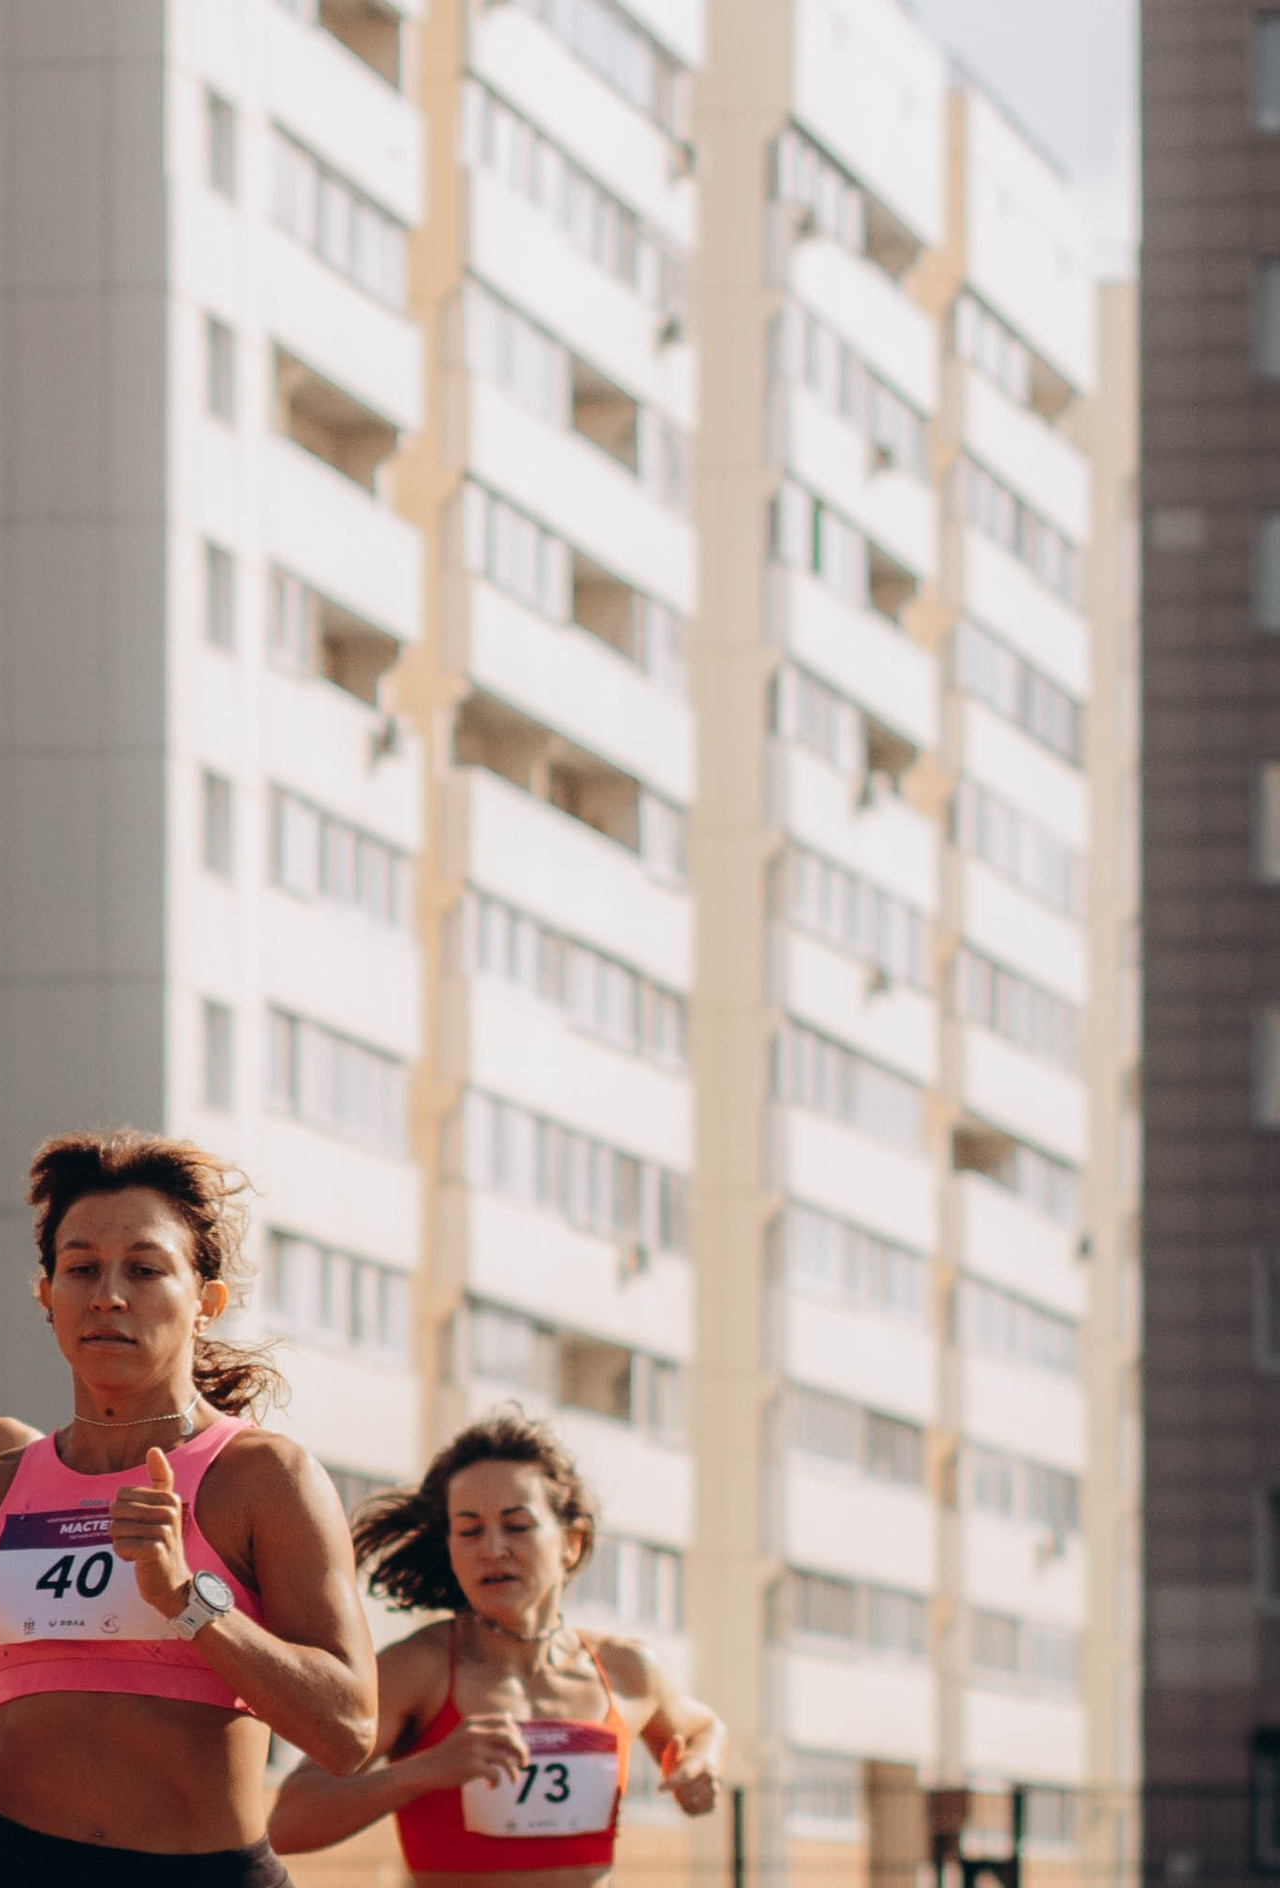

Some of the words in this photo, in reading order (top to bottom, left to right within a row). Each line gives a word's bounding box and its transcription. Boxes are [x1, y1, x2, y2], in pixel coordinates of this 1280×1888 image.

[59, 1519, 113, 1534] МАСТЕ
[35, 1551, 114, 1599] 40
[516, 1763, 570, 1804] 73
